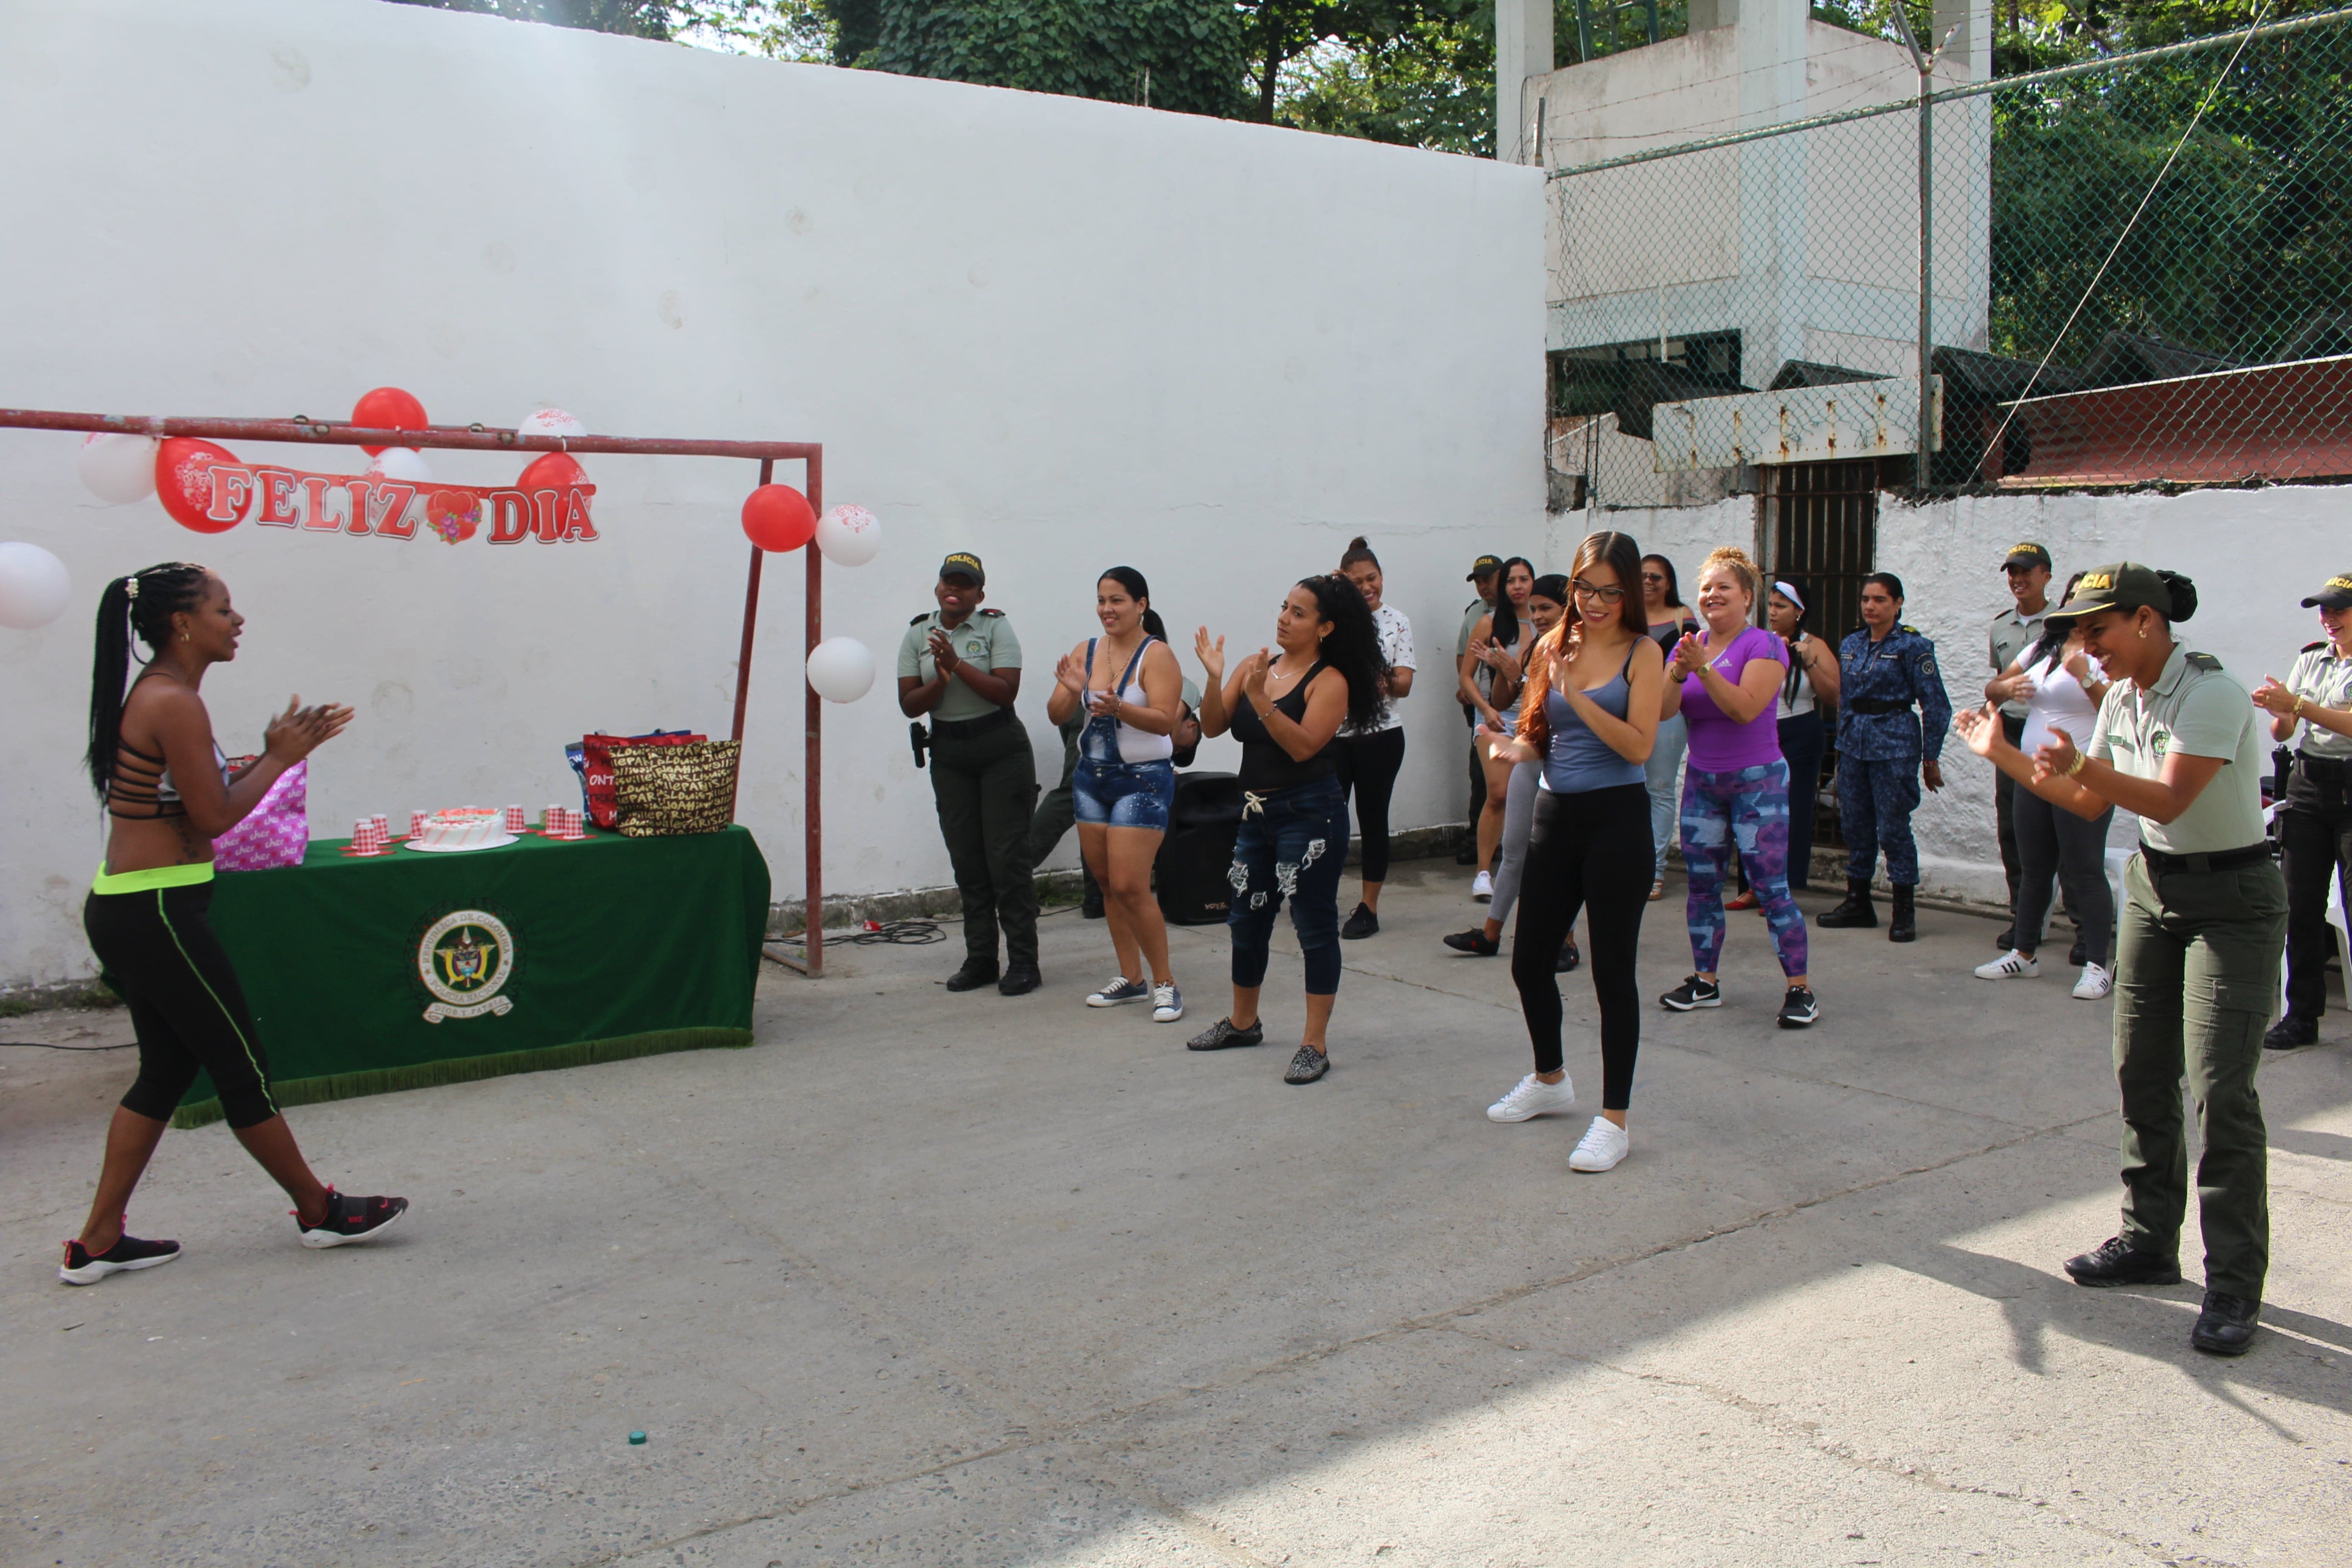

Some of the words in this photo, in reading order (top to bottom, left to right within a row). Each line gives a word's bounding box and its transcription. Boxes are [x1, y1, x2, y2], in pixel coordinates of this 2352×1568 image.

[206, 465, 417, 540] FELIZ
[487, 487, 599, 544] DIA
[946, 554, 979, 571] POLICIA
[477, 915, 510, 954] COLOMBIA
